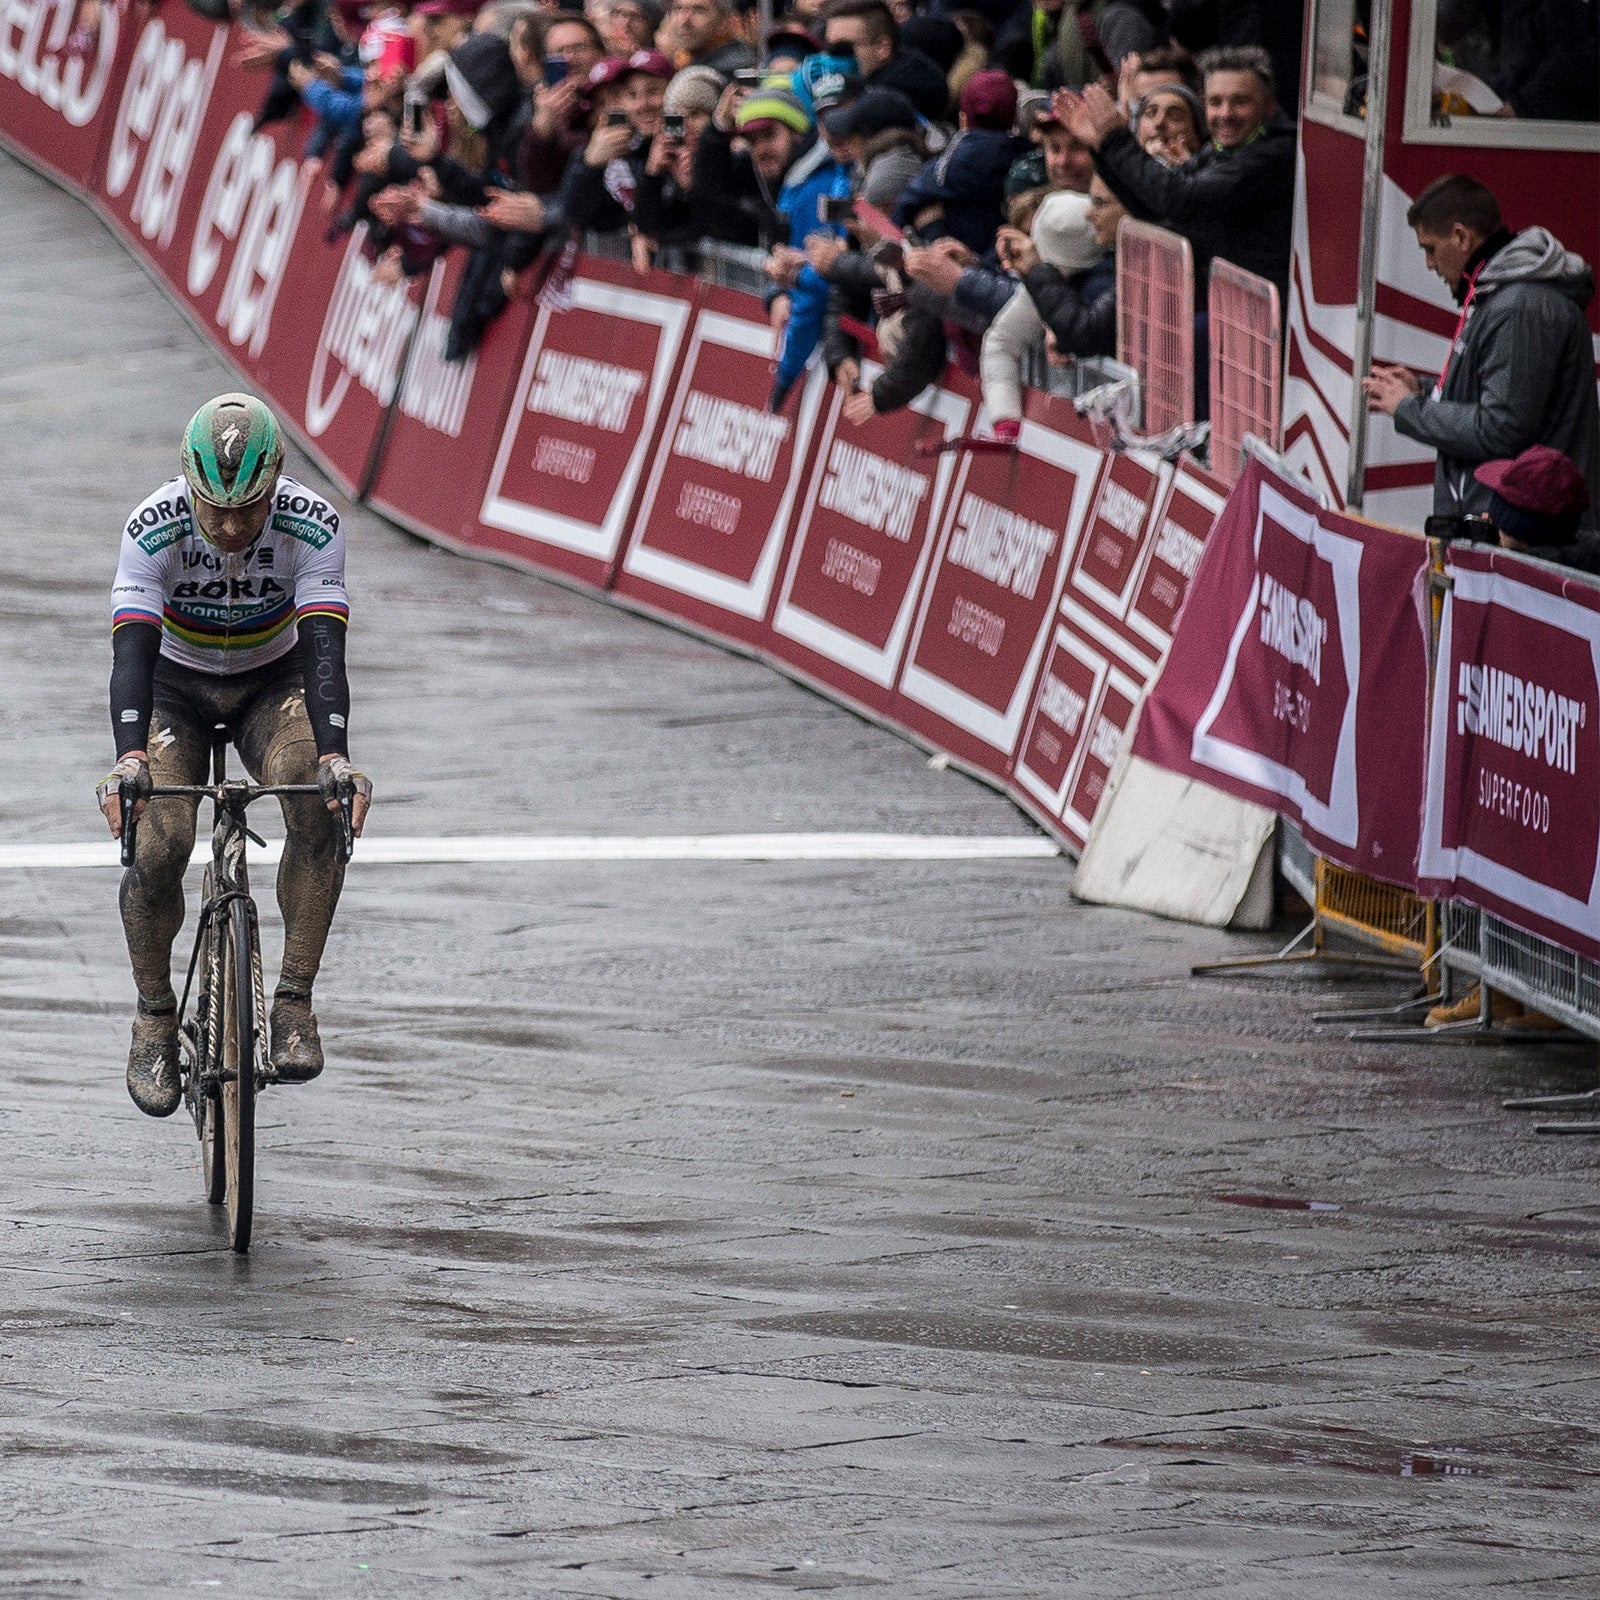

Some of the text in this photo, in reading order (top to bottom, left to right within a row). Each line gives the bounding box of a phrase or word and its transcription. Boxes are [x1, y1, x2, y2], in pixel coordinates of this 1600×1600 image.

[106, 18, 230, 253] enel
[187, 110, 314, 360] enel
[127, 496, 191, 540] BORA
[277, 494, 340, 535] BORA
[188, 551, 221, 571] UCI
[173, 577, 285, 600] BORA
[1478, 767, 1550, 834] SUPERFOOD
